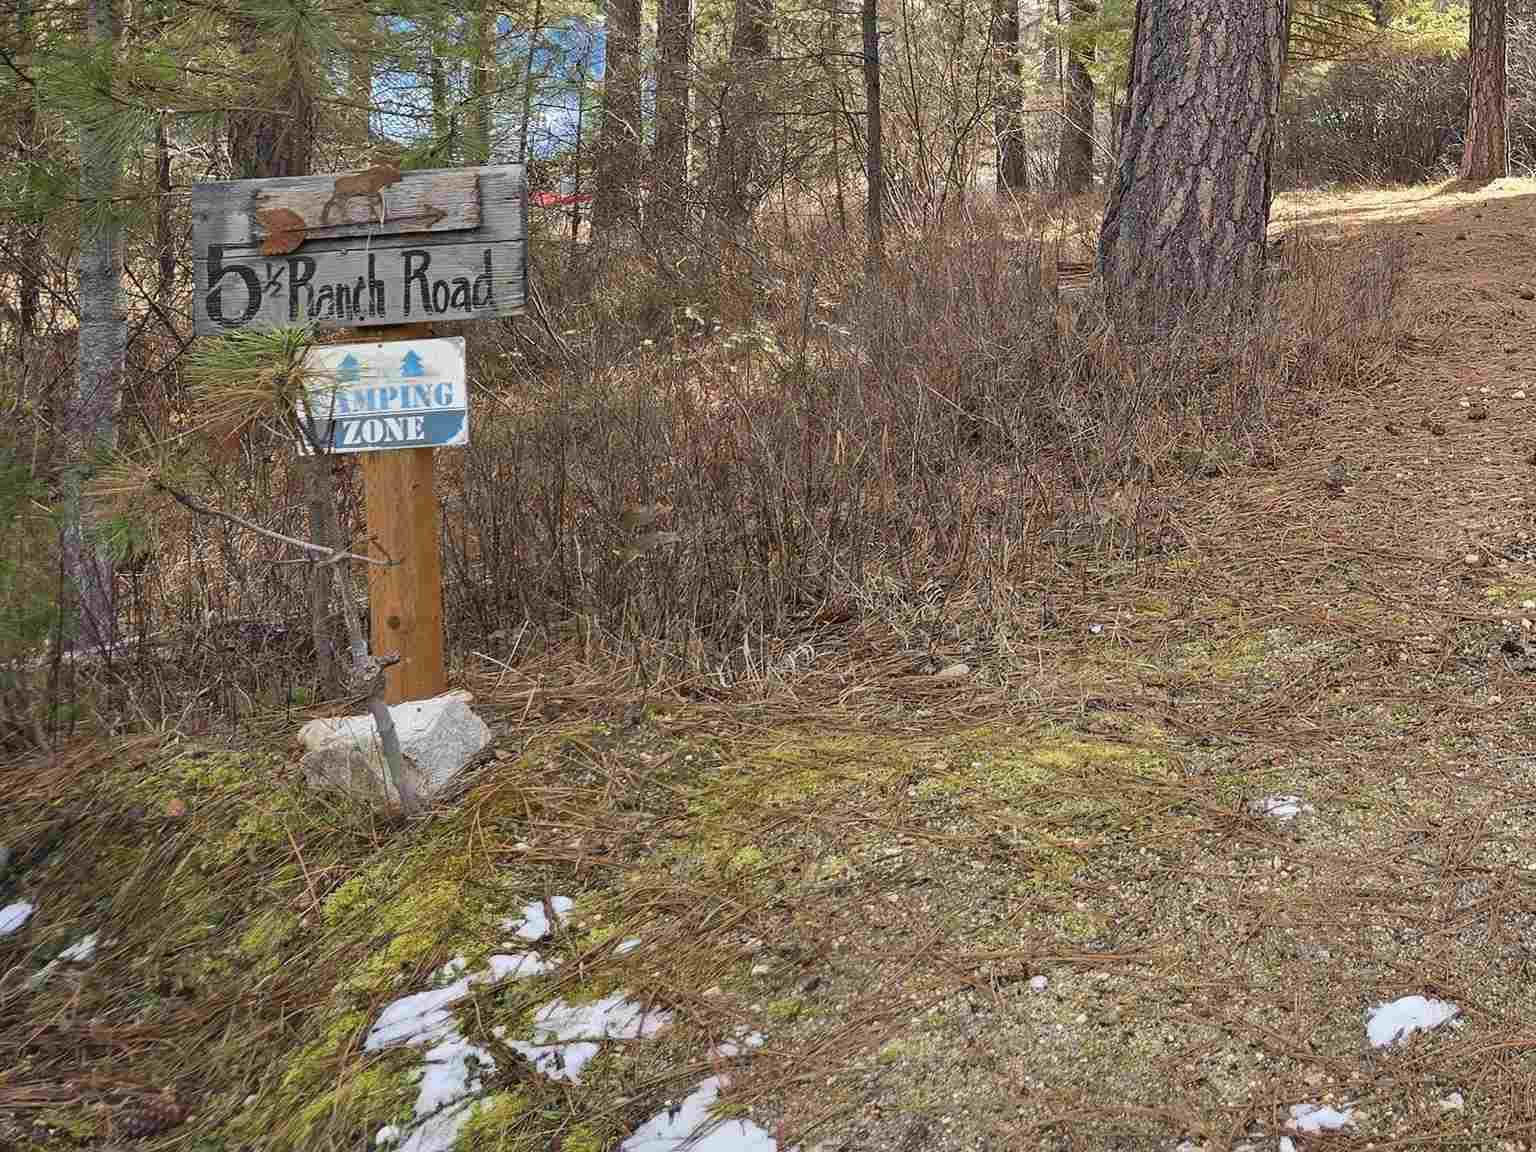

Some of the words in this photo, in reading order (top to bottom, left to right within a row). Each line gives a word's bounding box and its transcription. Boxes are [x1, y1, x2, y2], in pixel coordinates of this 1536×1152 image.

[288, 253, 385, 322] Ranch
[404, 249, 493, 316] Road
[343, 416, 424, 445] ZONE
